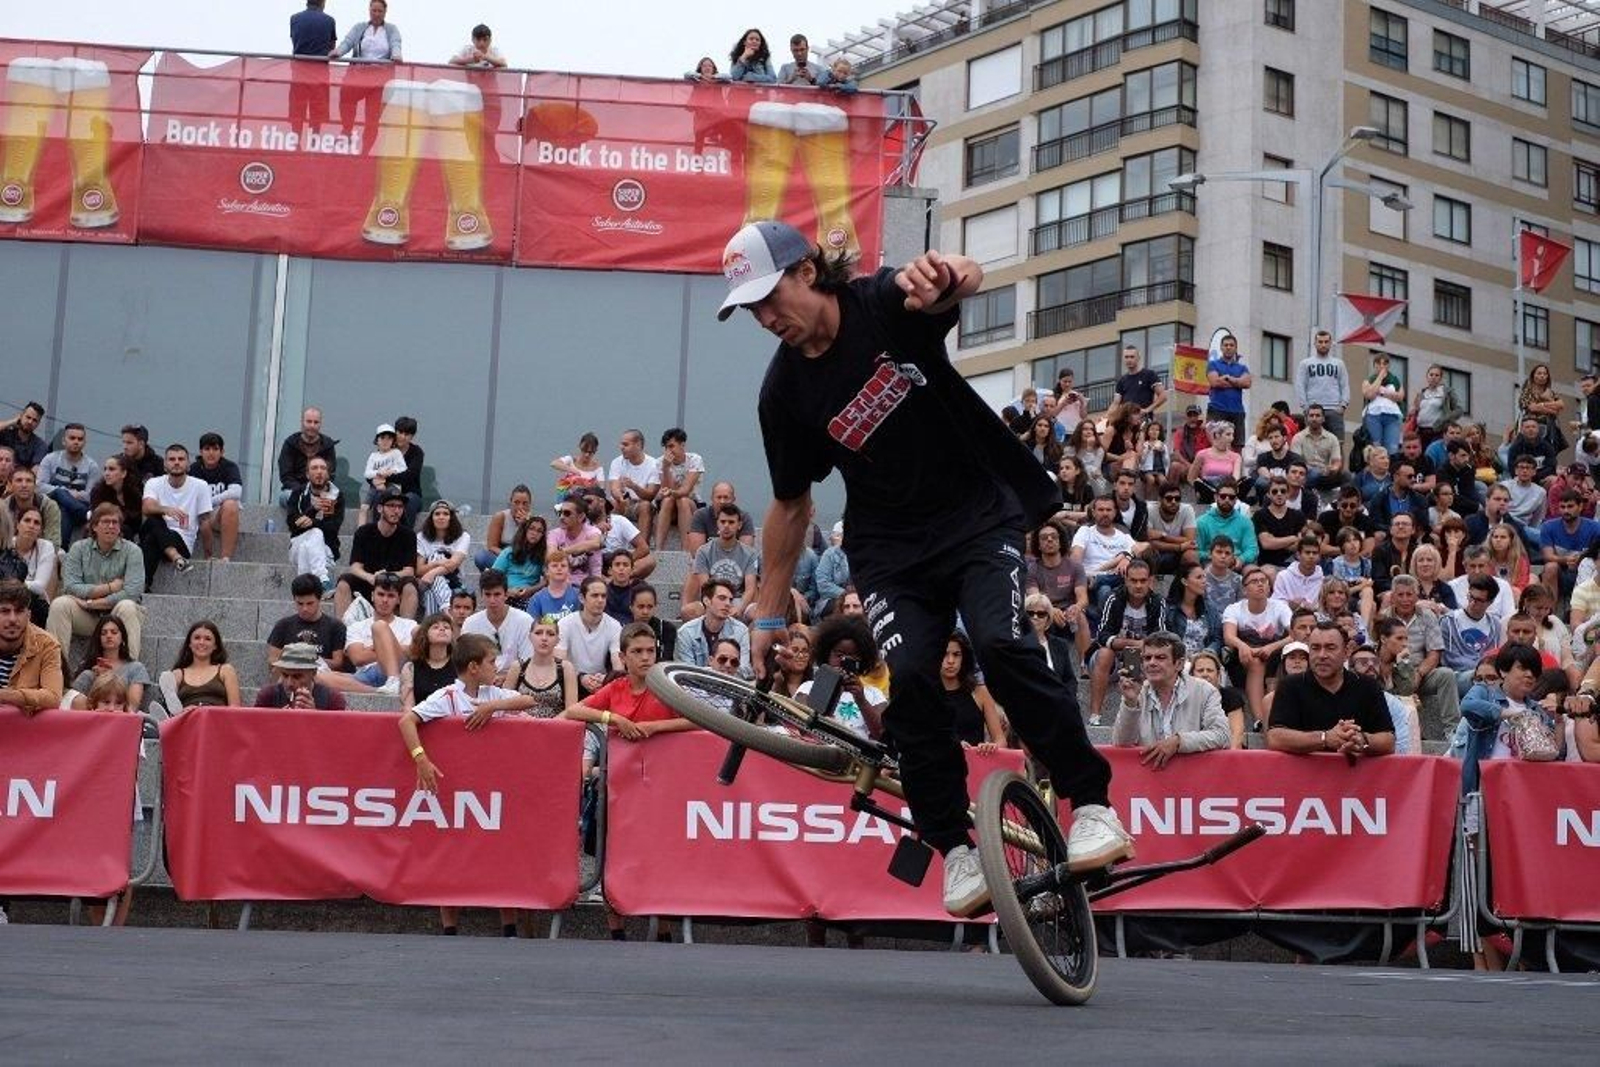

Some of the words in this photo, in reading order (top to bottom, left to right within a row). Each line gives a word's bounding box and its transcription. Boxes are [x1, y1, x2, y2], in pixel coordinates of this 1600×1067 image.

[166, 119, 222, 147] Bock
[229, 122, 252, 147] to
[260, 125, 299, 151] the
[306, 127, 361, 155] beat
[538, 141, 592, 166] Bock
[599, 145, 623, 169] to
[631, 147, 667, 171] the
[676, 149, 728, 174] beat
[234, 784, 502, 831] NISSAN
[1130, 797, 1387, 836] NISSAN
